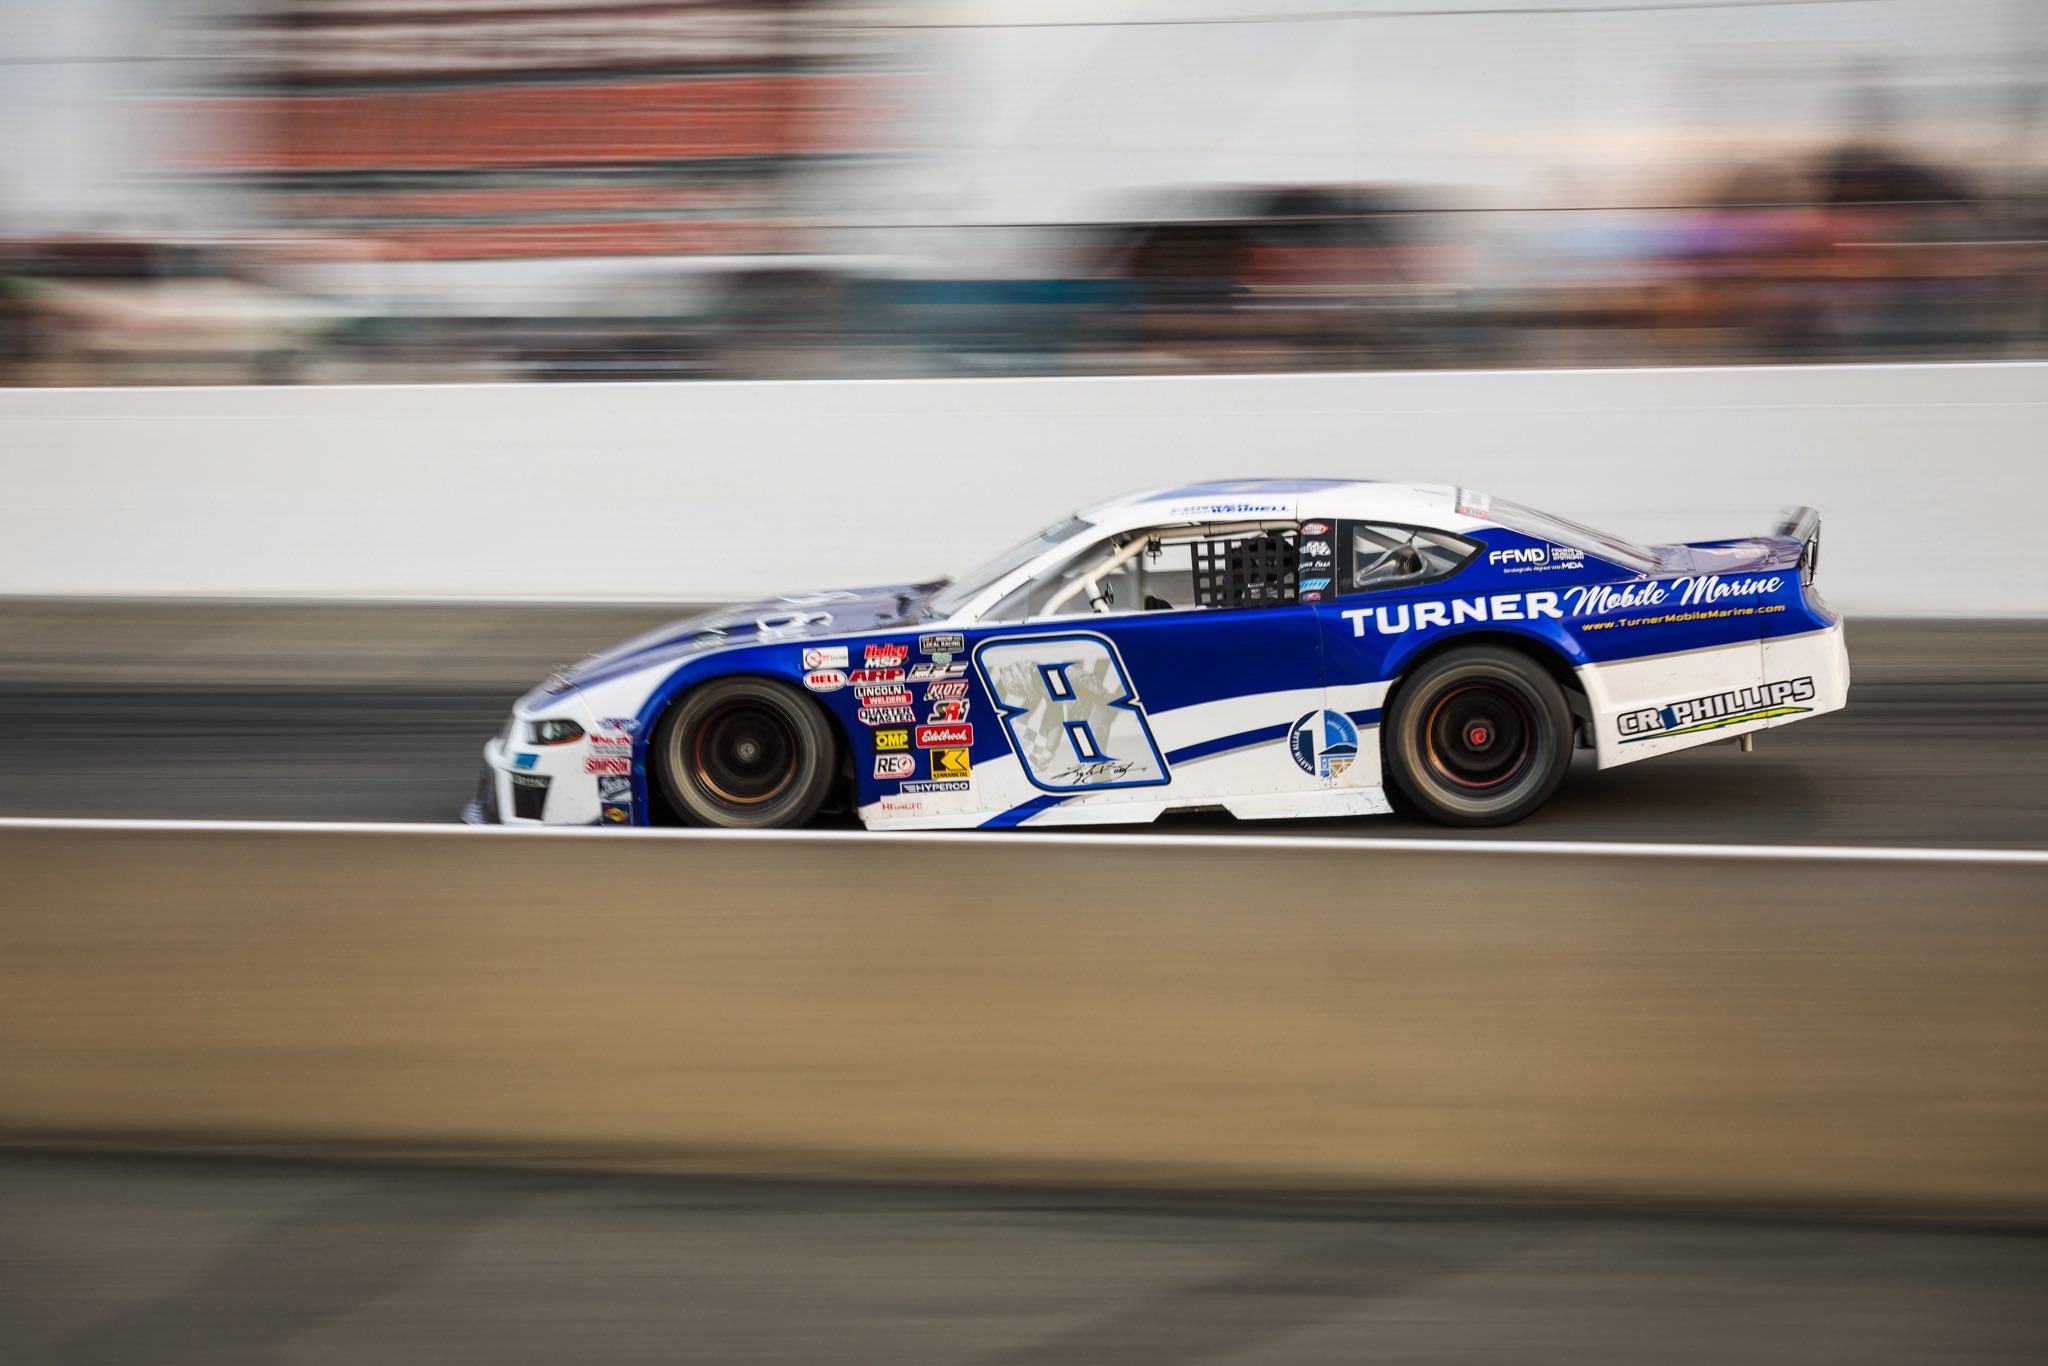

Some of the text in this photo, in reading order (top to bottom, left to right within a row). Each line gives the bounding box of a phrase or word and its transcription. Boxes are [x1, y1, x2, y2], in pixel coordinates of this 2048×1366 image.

[1489, 548, 1545, 565] FFMD
[1561, 562, 1584, 570] MDA
[1341, 575, 1785, 637] TURNER Mobile Marine
[1581, 604, 1786, 631] www.TurnerMobileMarine.com
[865, 643, 908, 659] Holley
[865, 656, 902, 668] MSD
[811, 674, 840, 684] BELL
[850, 669, 904, 682] ARP
[857, 685, 902, 697] LINCOLN
[929, 683, 966, 699] KLOTZ
[869, 695, 907, 704] WELDERS
[1664, 675, 1815, 725] PHILLIPS
[859, 707, 911, 719] QUARTER
[869, 713, 913, 722] MASTER
[972, 630, 1171, 796] 8
[876, 734, 908, 746] OMP
[921, 729, 967, 742] Edelbrock
[916, 782, 968, 792] HYPERCO
